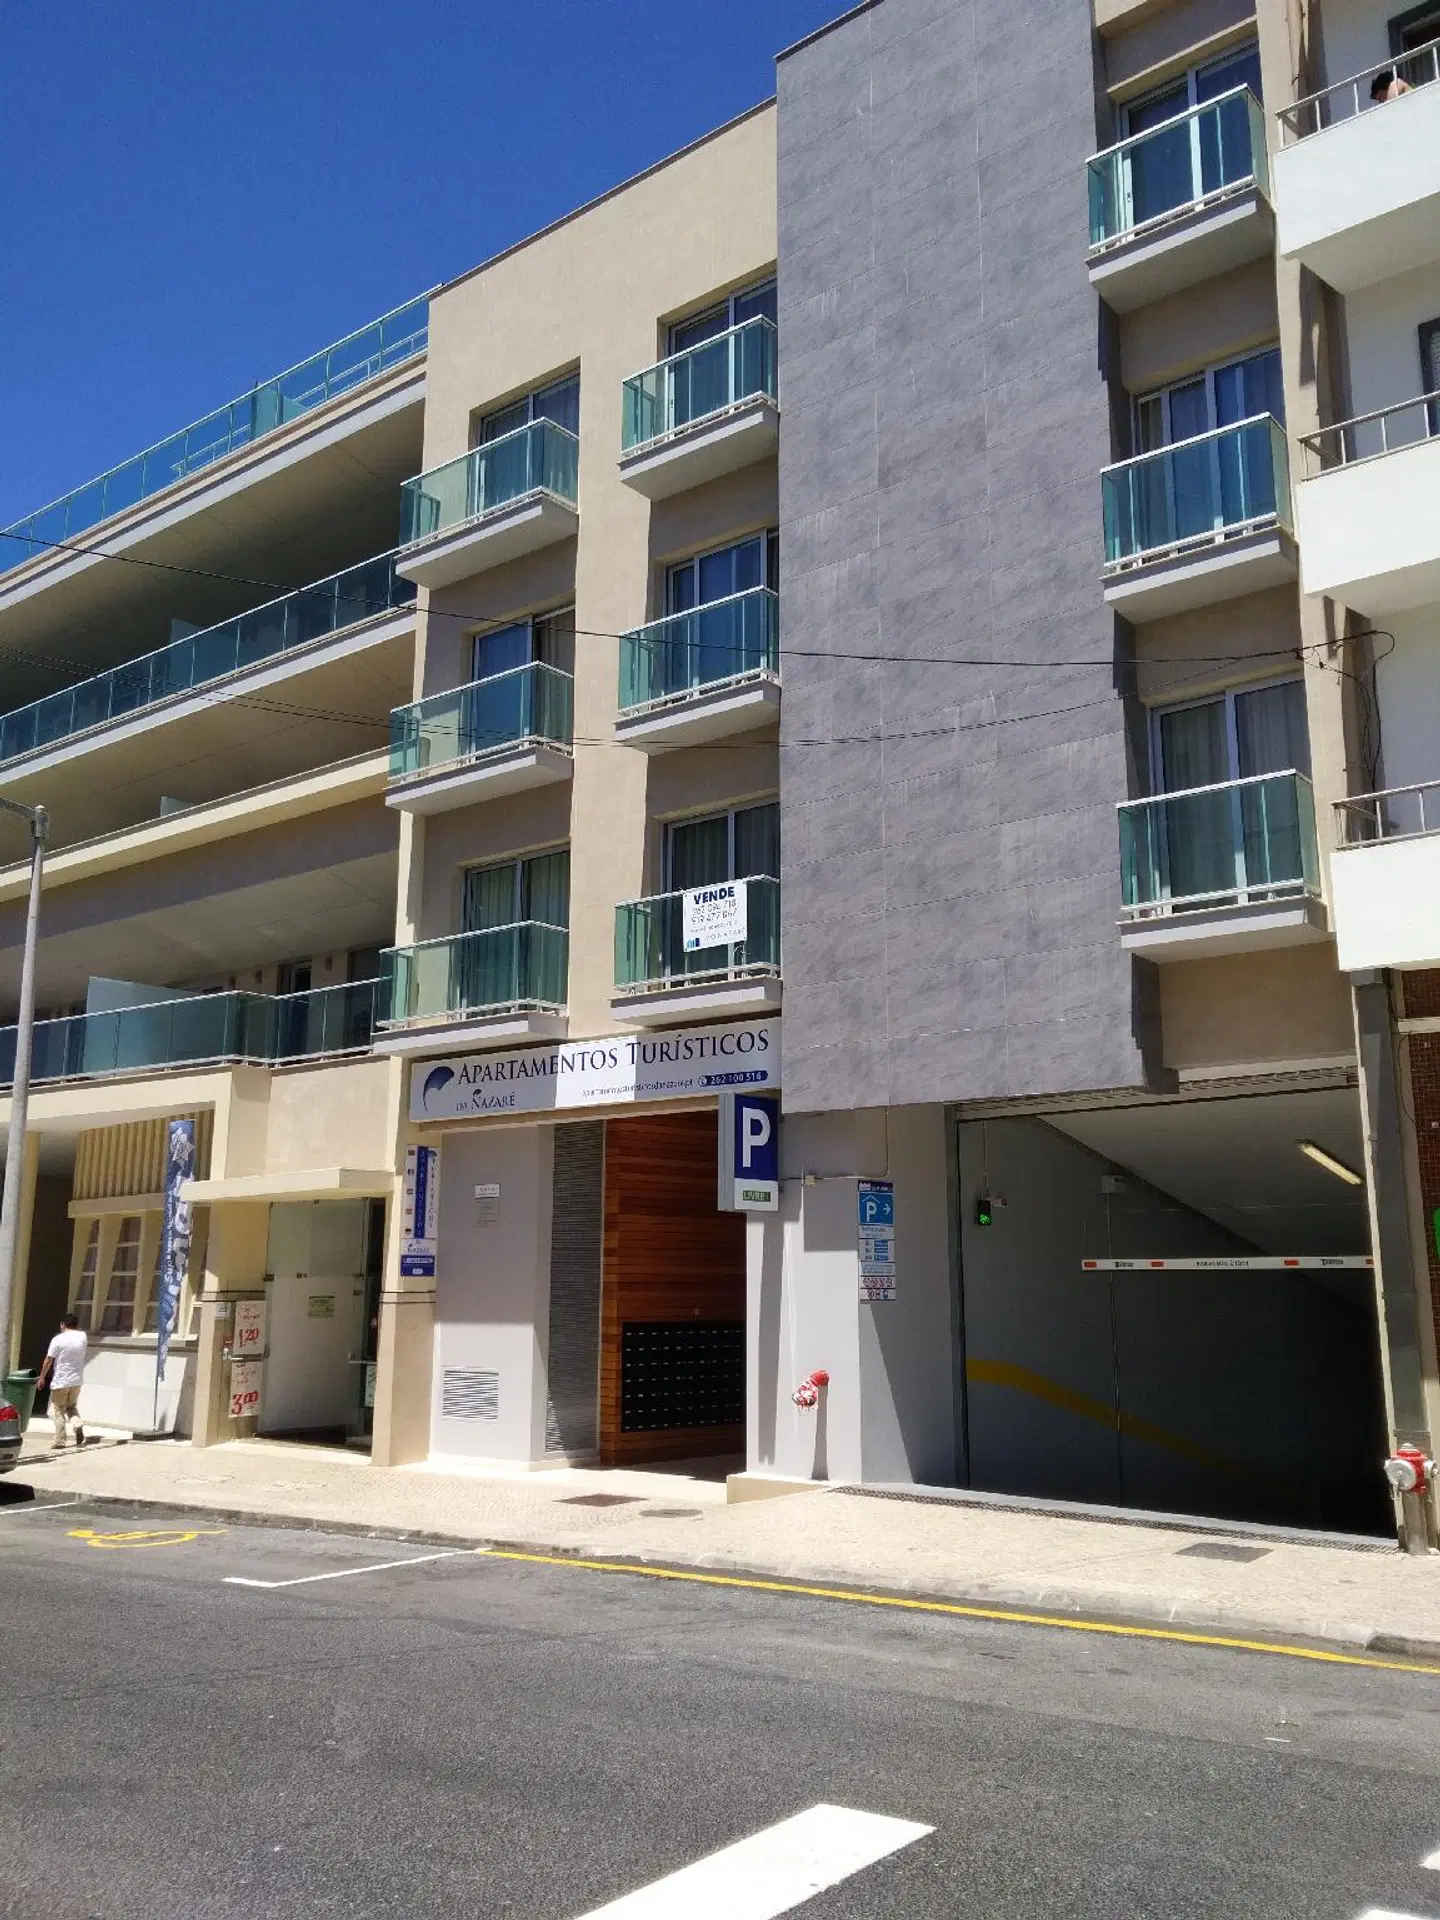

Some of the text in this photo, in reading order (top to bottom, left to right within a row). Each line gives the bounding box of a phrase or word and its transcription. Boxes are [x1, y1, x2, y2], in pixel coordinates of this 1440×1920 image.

[693, 887, 735, 904] VENDE
[458, 1028, 770, 1085] APARTAMENTOS TURÍSTICOS
[710, 1075, 726, 1085] 262
[745, 1071, 762, 1082] 516
[742, 1106, 771, 1168] P
[866, 1201, 878, 1222] P
